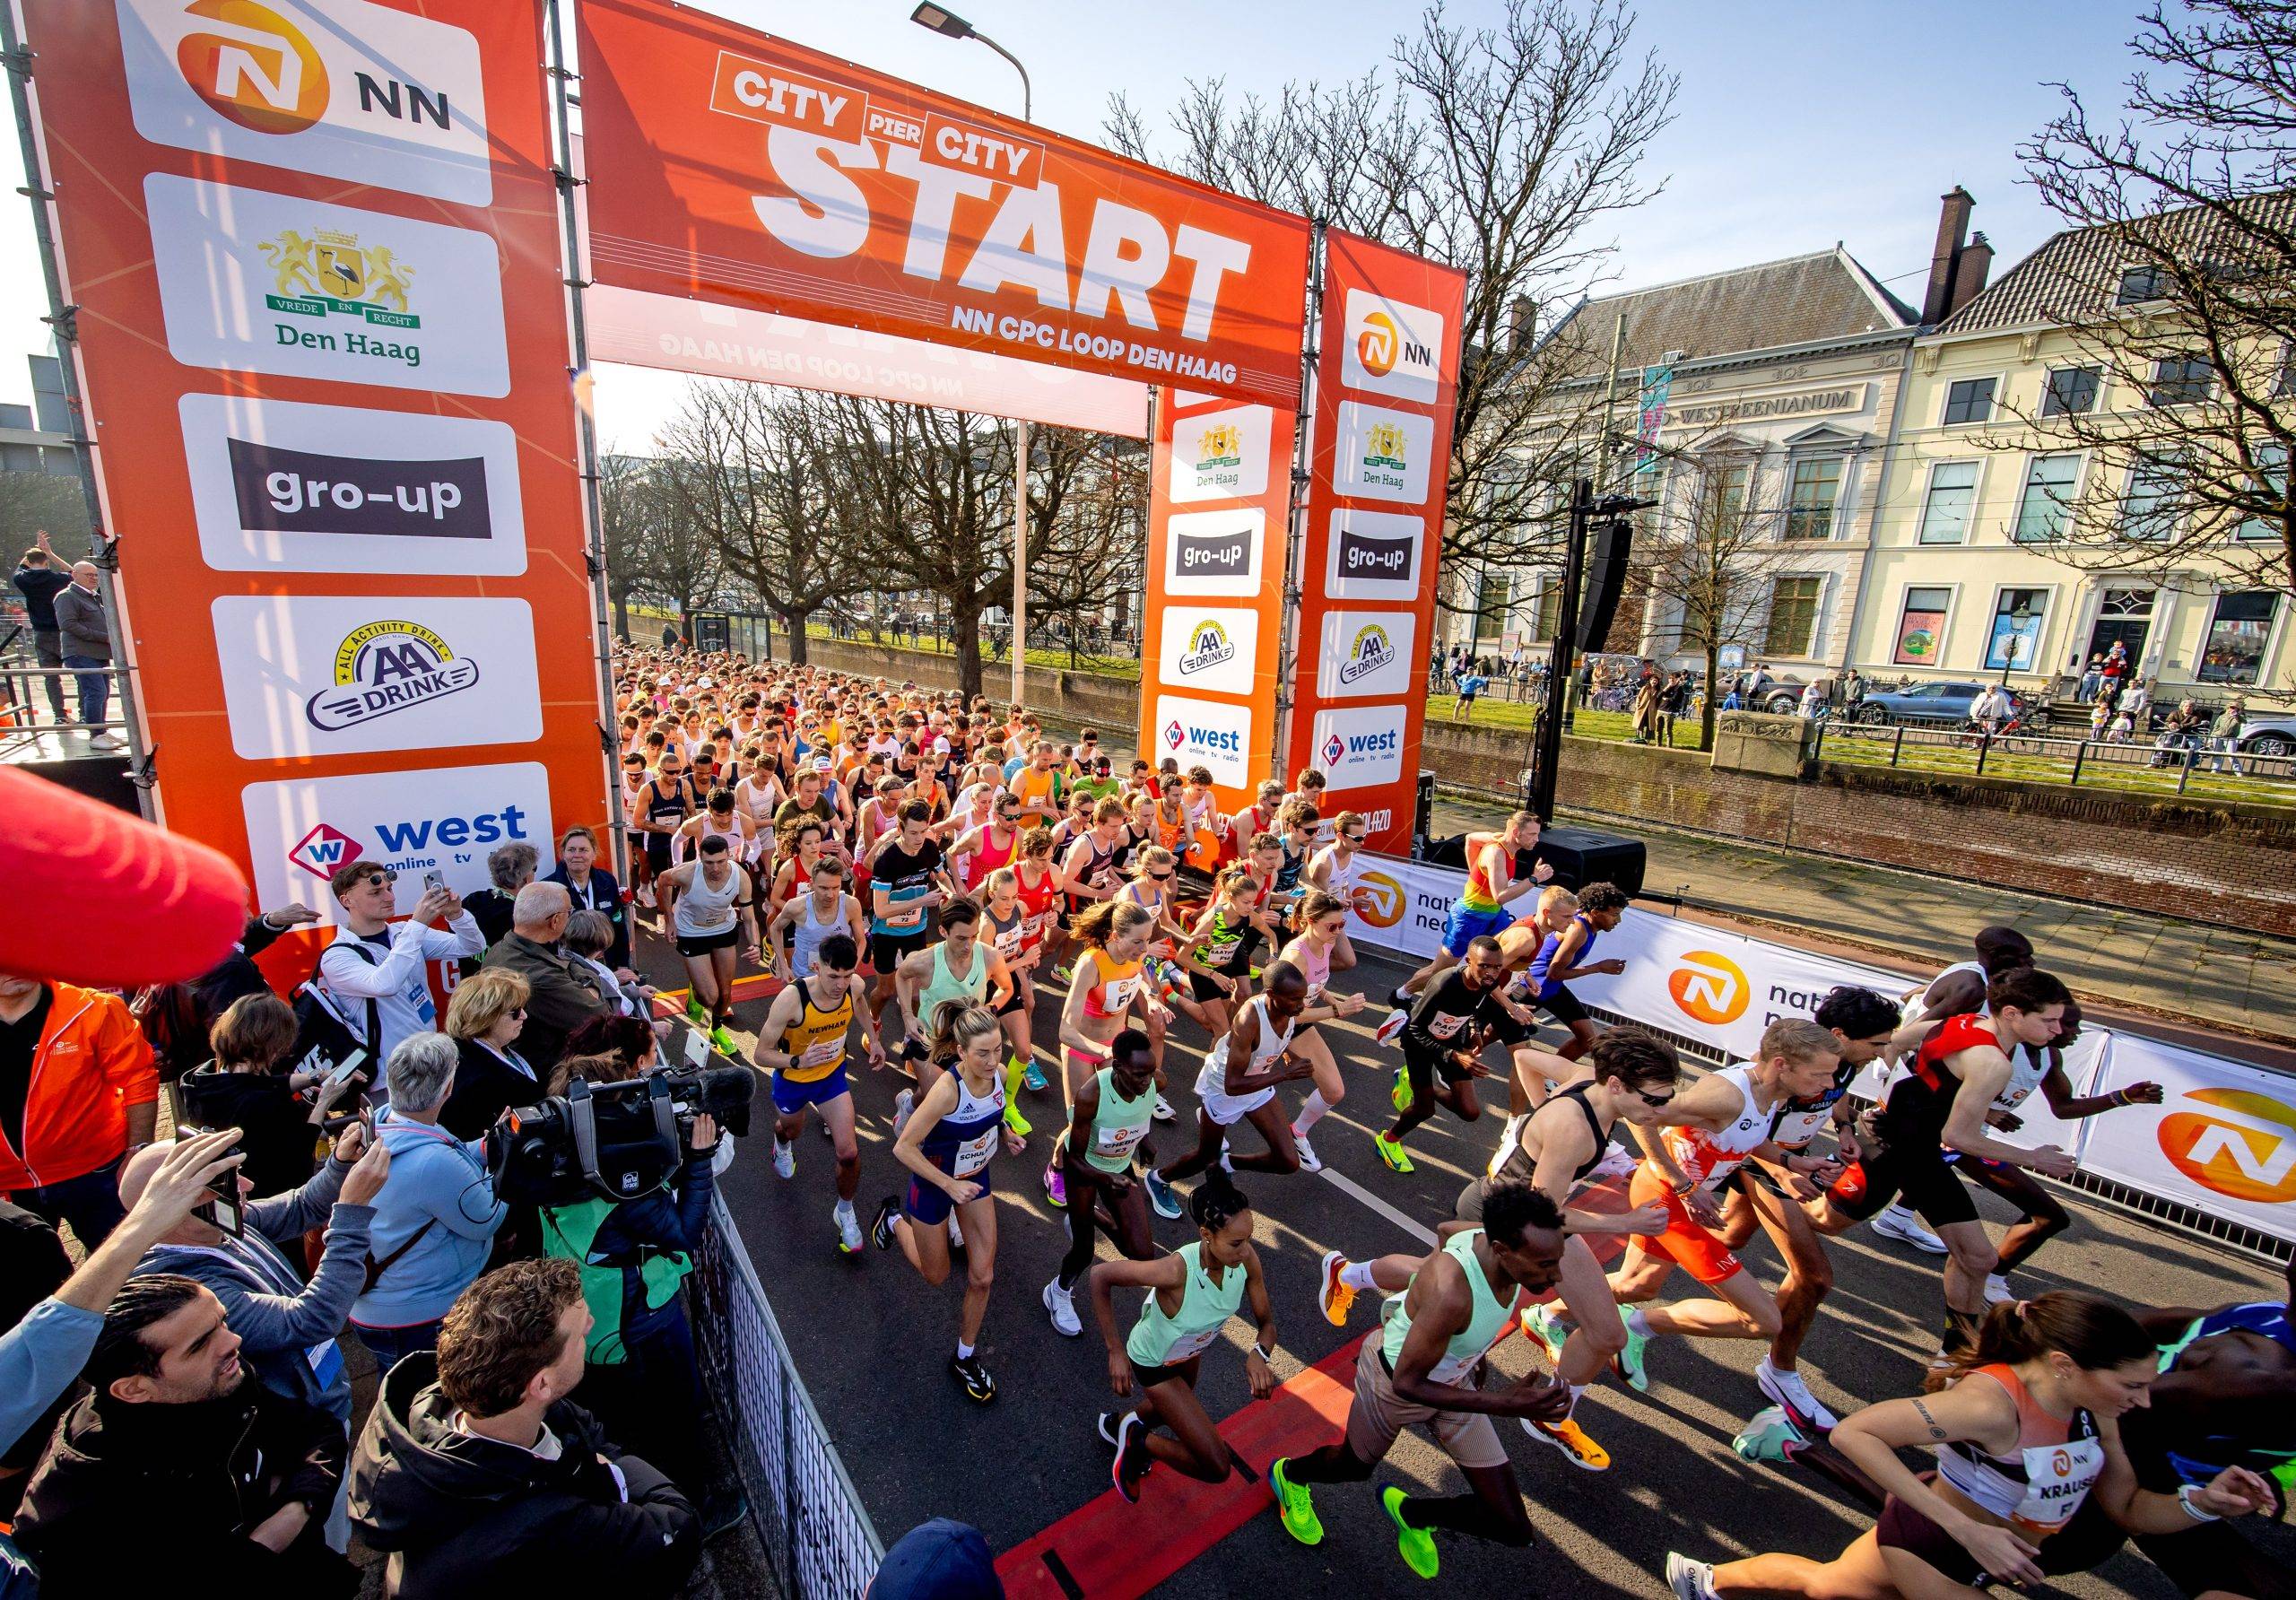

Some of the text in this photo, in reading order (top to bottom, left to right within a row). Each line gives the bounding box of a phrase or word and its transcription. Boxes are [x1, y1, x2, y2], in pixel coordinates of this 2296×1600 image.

[353, 71, 451, 131] NN
[733, 70, 848, 127] CITY
[870, 114, 921, 143] PIER
[935, 126, 1031, 178] CITY
[750, 122, 1252, 343] START
[276, 300, 413, 327] VREDE EN RECHT
[274, 324, 422, 368] Den Haag
[951, 305, 1238, 385] NN CPC LOOP DEN HAAG
[1404, 342, 1431, 367] NN
[1196, 473, 1239, 487] Den Haag
[1363, 471, 1405, 490] Den Haag
[266, 471, 463, 521] gro-up
[1184, 543, 1242, 567] gro-up
[1348, 545, 1405, 571] gro-up
[339, 622, 445, 670] ALL ACTIVITY DRINK
[1199, 632, 1221, 654] AA
[1361, 637, 1382, 660] AA
[371, 642, 436, 687] AA
[1196, 650, 1224, 667] DRINK
[1358, 654, 1387, 674] DRINK
[361, 671, 452, 712] DRINK
[1189, 726, 1239, 752] west
[1349, 729, 1396, 752] west
[1188, 748, 1206, 756] online
[1223, 754, 1239, 762] radio
[1380, 752, 1395, 761] radio
[374, 804, 527, 853] west
[1357, 809, 1392, 833] OLAZO
[385, 852, 472, 873] online tv
[1117, 992, 1132, 1008] F1
[808, 1019, 847, 1034] NEWHAM
[1797, 1134, 1811, 1142] 20
[2073, 1454, 2089, 1465] NN
